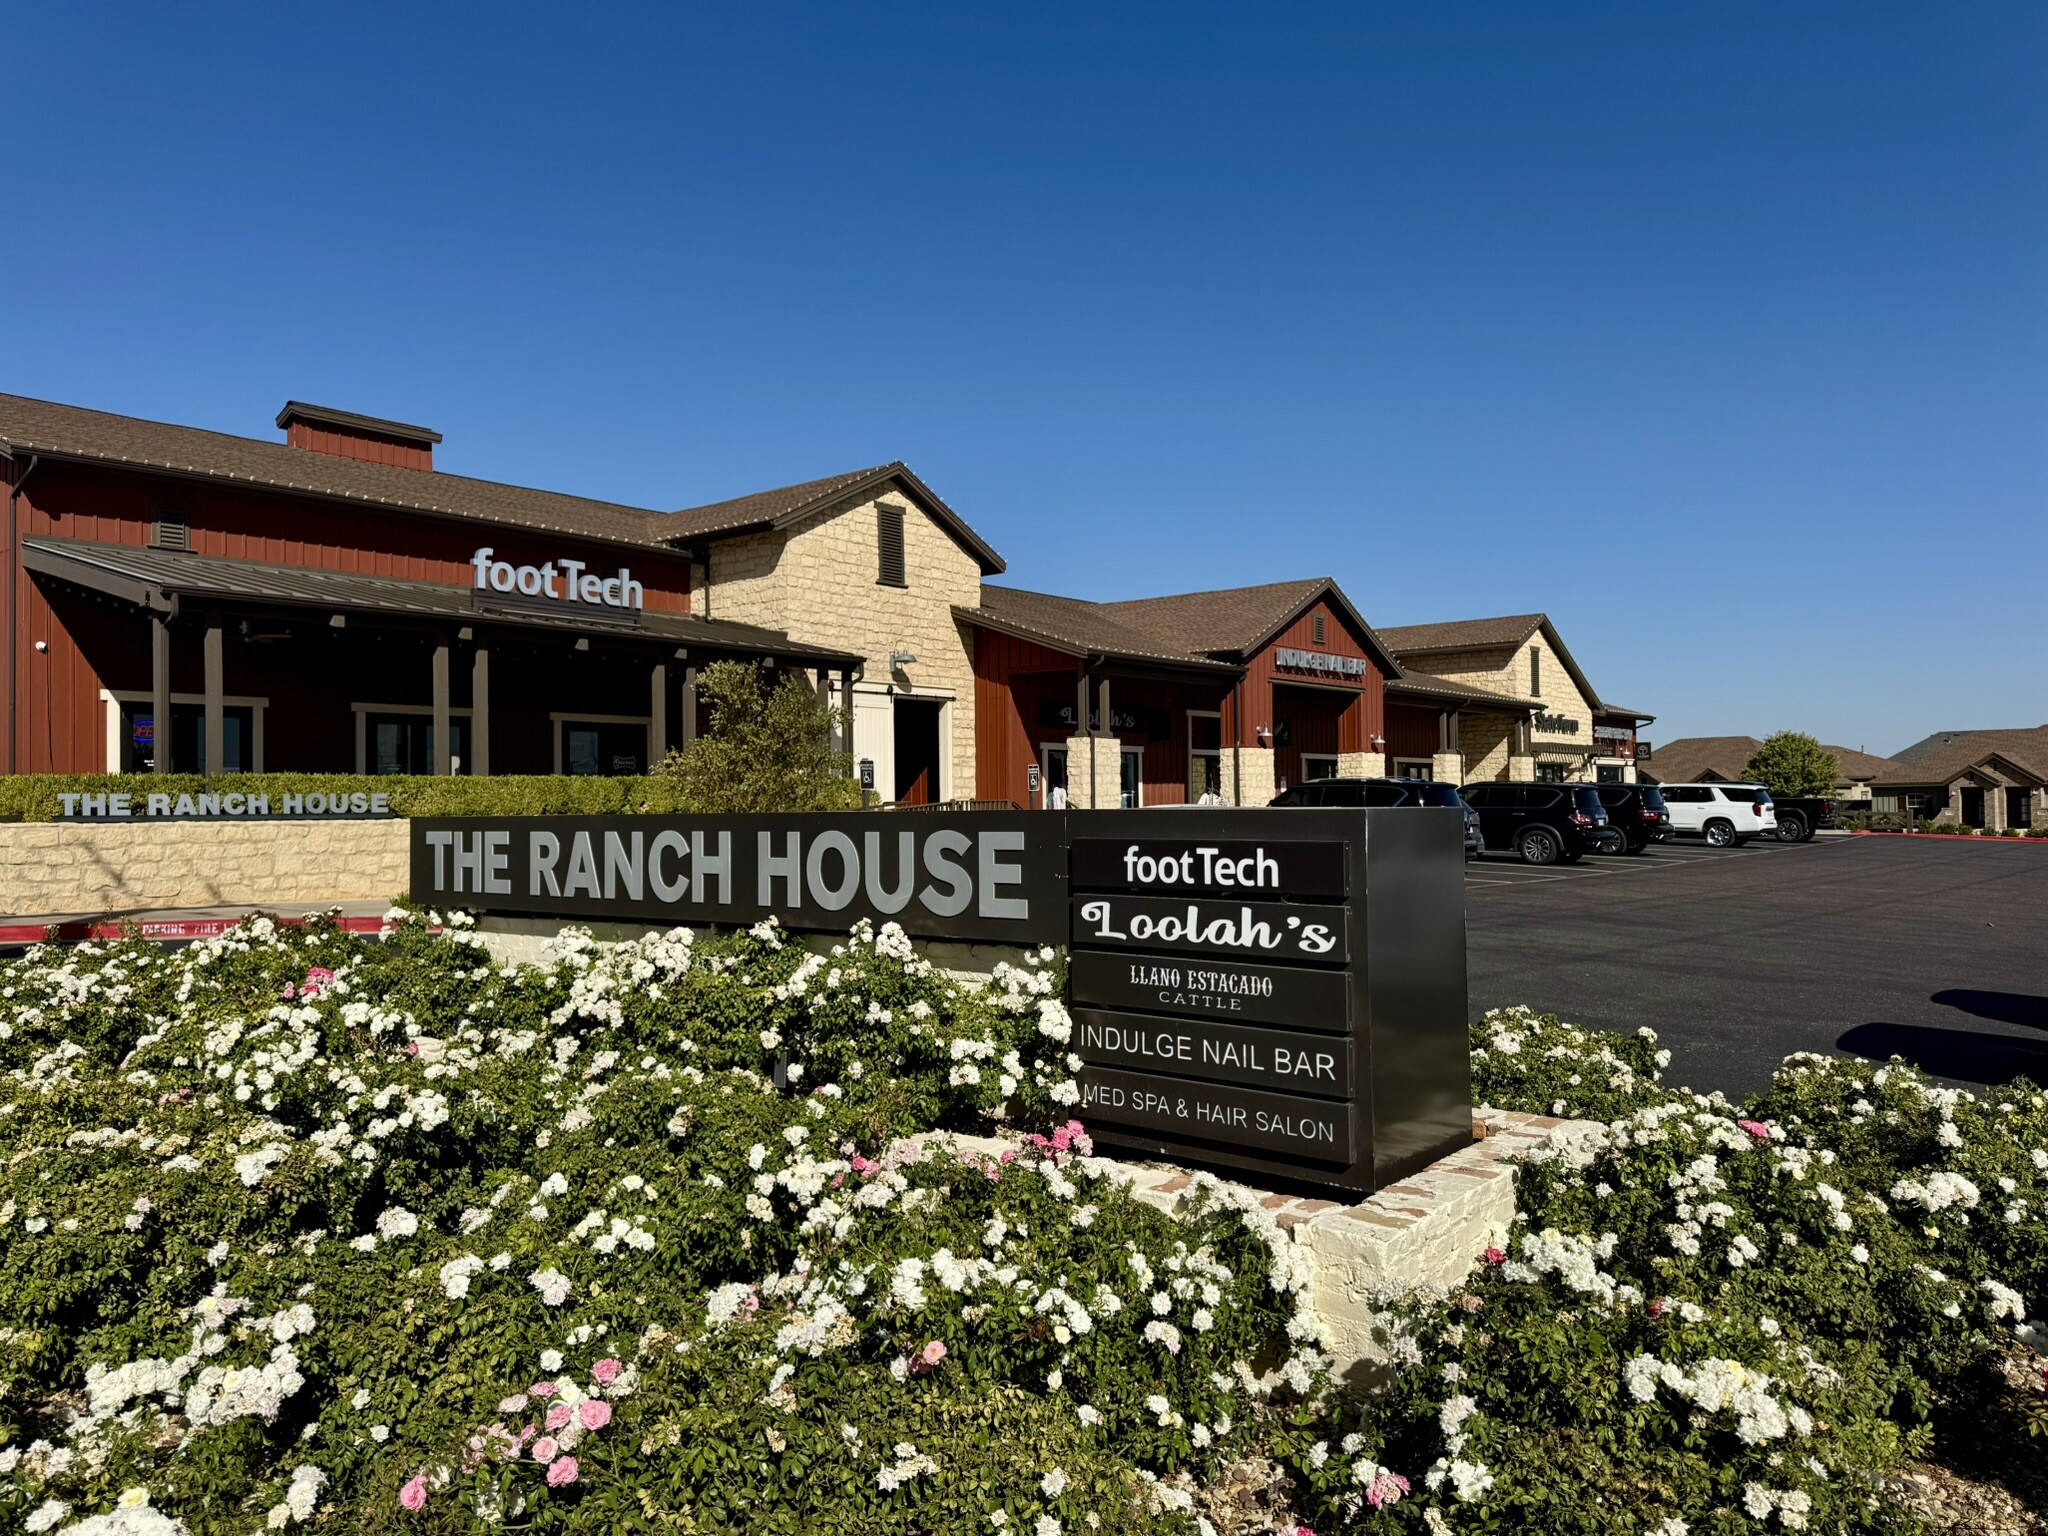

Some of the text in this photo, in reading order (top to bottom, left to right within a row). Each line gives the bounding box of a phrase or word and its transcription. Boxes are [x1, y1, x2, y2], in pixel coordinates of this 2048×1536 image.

[471, 546, 643, 609] footTech
[1276, 647, 1324, 671] INDULGE
[1347, 657, 1367, 675] BAR
[57, 792, 390, 817] THE RANCH HOUSE
[425, 829, 1029, 921] THE RANCH HOUSE
[1123, 845, 1279, 888] footTech
[1080, 900, 1337, 954] Loolah's
[1130, 964, 1273, 998] LLANO ESTACADO
[1158, 991, 1242, 1011] CATTLE
[1080, 1023, 1337, 1081] INDULGE NAIL BAR
[1083, 1084, 1334, 1143] MED SPA & HAIR SALON
